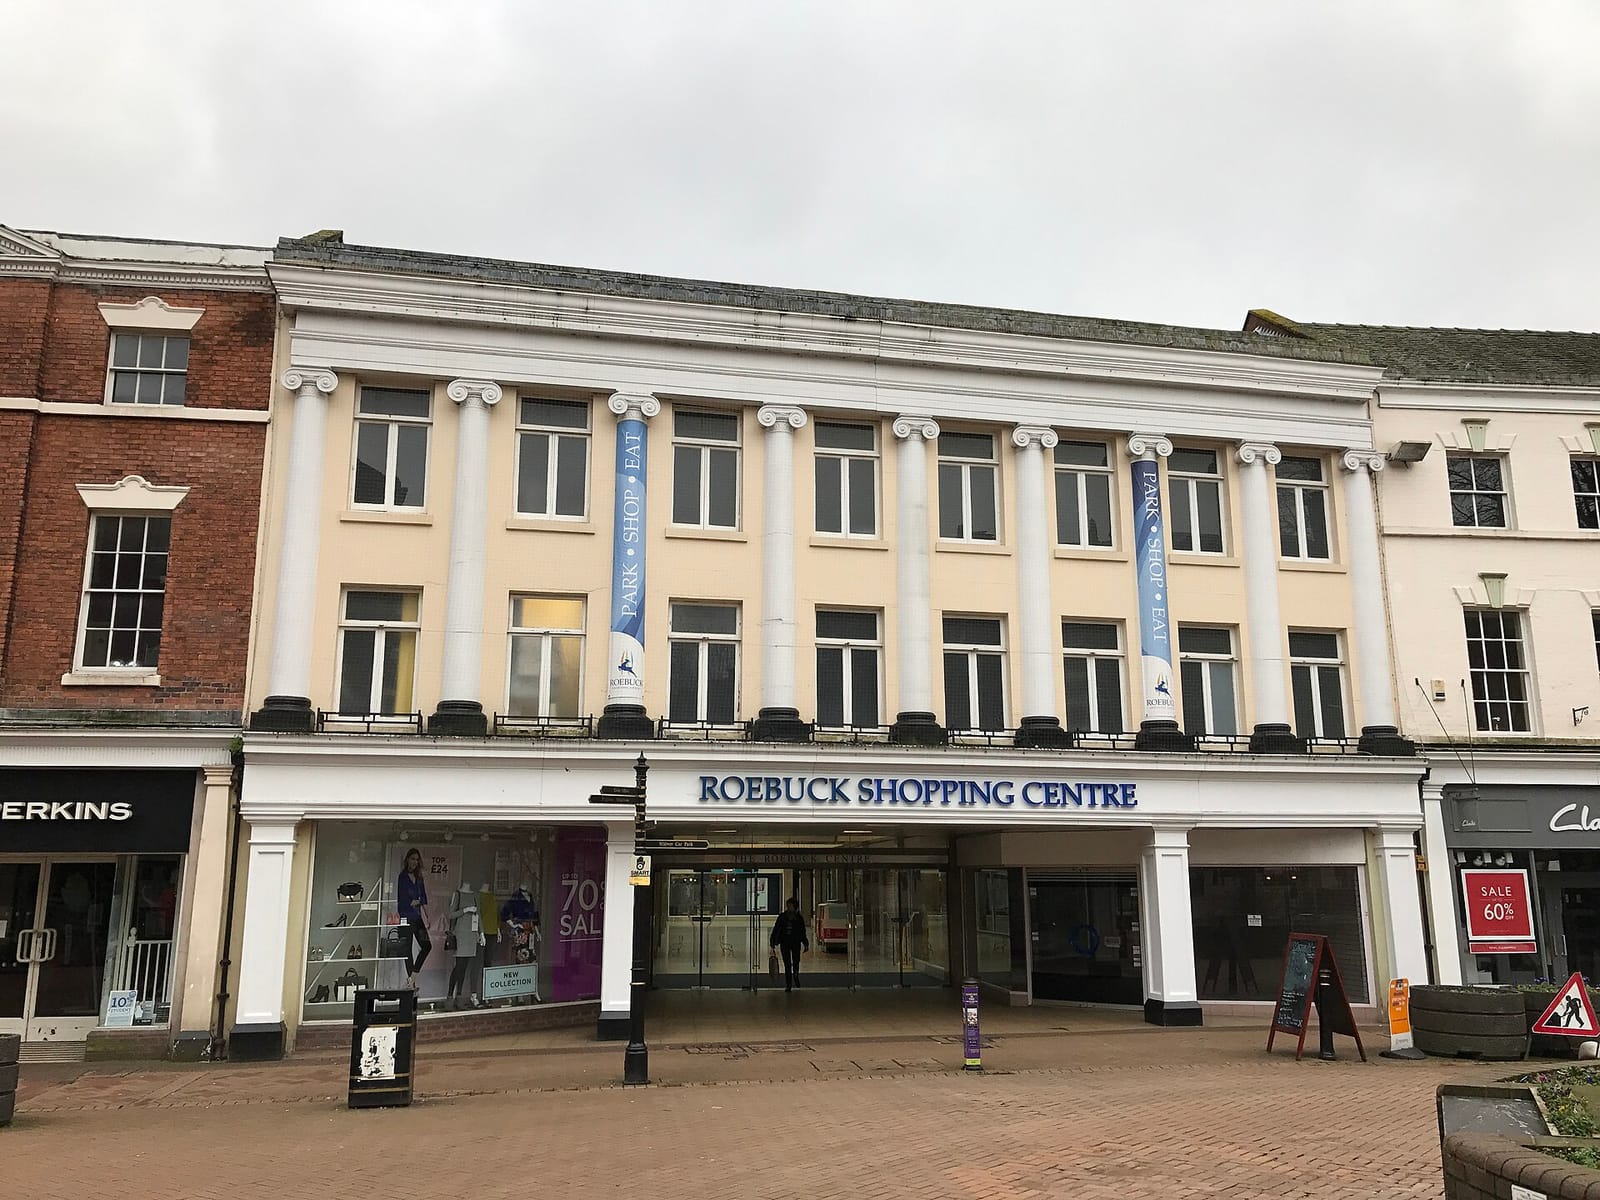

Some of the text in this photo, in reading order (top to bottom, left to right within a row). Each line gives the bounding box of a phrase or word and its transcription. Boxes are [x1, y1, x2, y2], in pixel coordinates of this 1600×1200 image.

[621, 431, 641, 617] PARK SHOP EAT
[1143, 471, 1169, 643] PARK SHOP EAT
[699, 775, 1138, 808] ROEBUCK SHOPPING CENTRE
[0, 801, 133, 821] ERKINS
[431, 856, 447, 864] TOP
[735, 854, 753, 863] THE
[825, 854, 872, 863] CENTRE
[430, 864, 449, 874] £24
[561, 879, 605, 911] 70
[1481, 886, 1512, 897] SALE
[1484, 903, 1514, 920] 60%
[560, 914, 602, 936] SAL
[490, 978, 532, 989] COLLECTION
[503, 971, 519, 979] NEW
